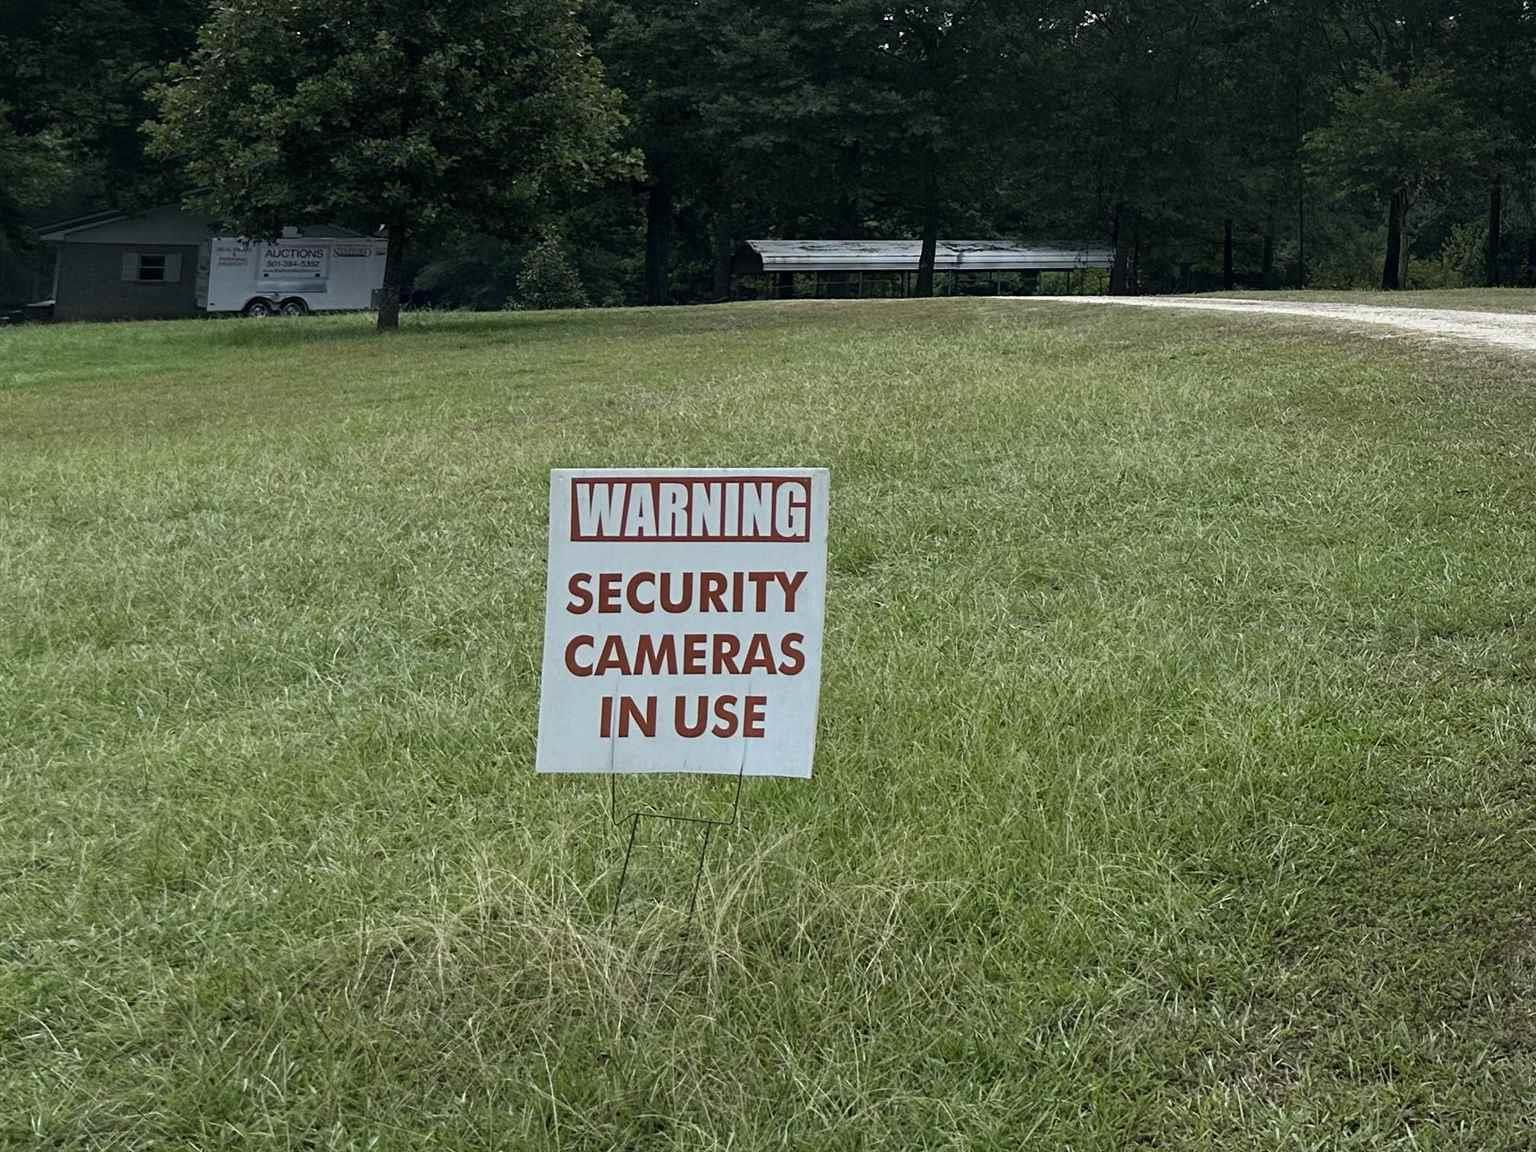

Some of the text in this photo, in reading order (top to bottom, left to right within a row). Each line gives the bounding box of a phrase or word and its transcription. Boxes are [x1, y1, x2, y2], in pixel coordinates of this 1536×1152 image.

[264, 248, 325, 258] AUCTIONS
[575, 482, 807, 538] WARNING
[566, 571, 808, 615] SECURITY
[564, 633, 806, 677] CAMERAS
[599, 695, 767, 738] IN USE
